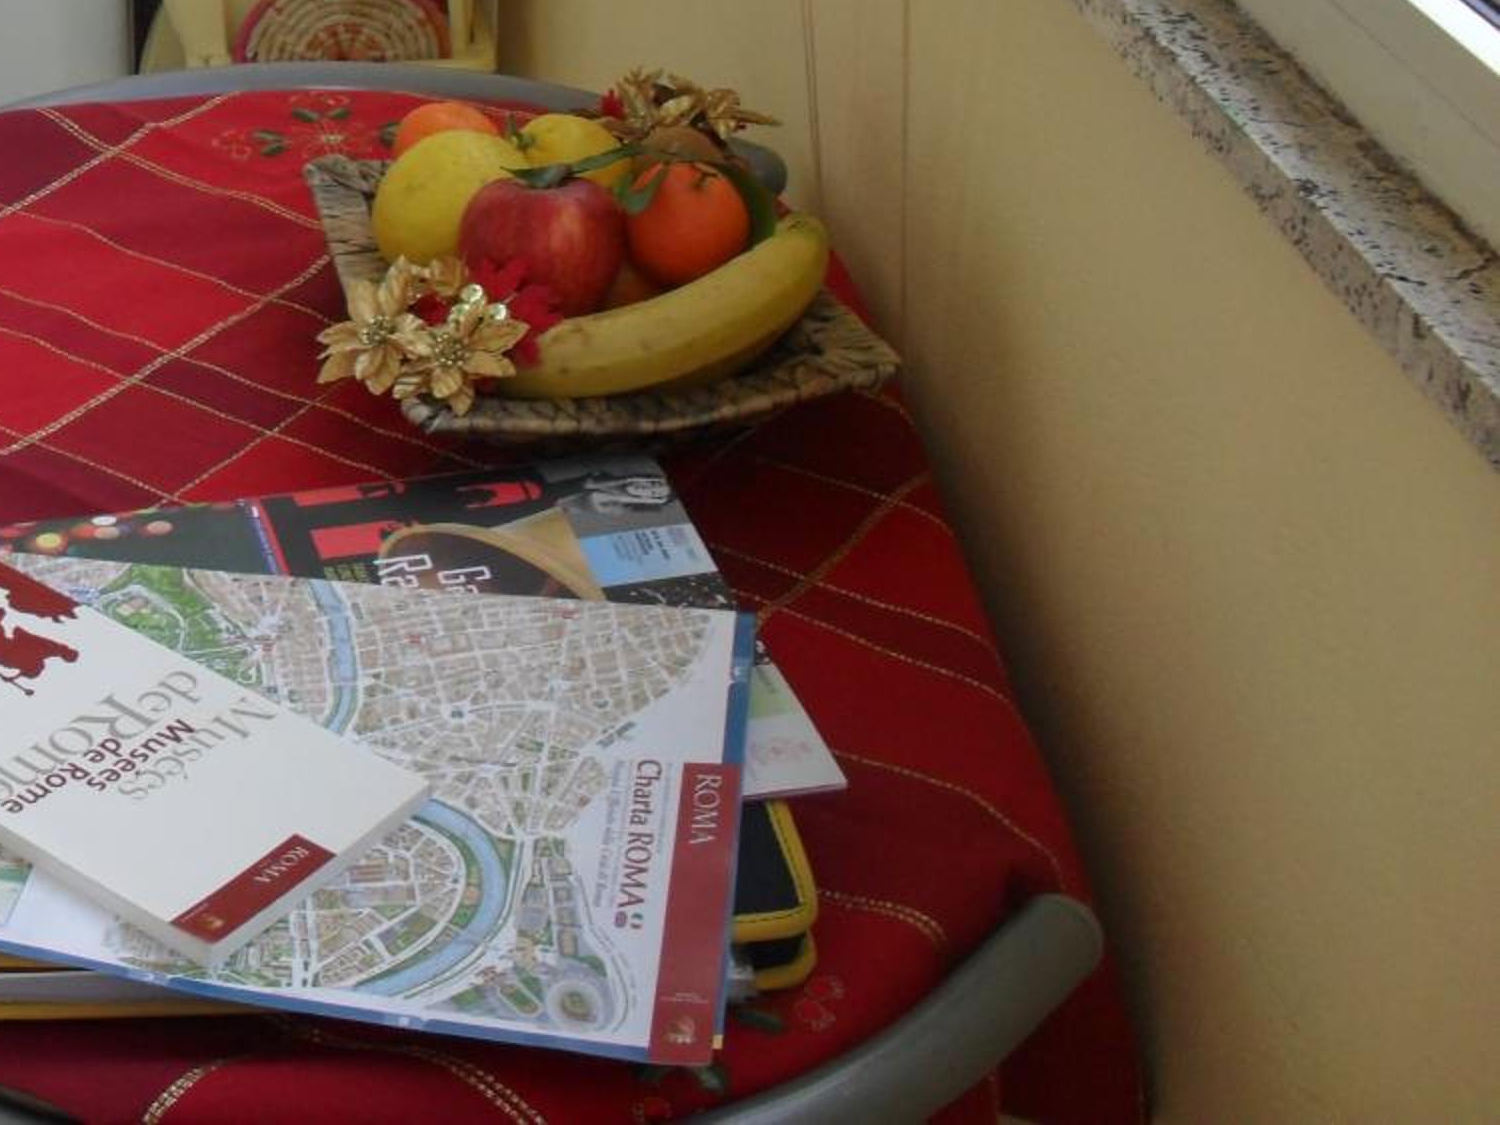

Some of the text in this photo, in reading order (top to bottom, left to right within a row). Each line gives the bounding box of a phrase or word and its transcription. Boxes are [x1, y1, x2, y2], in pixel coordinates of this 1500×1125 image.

[1, 738, 121, 815] de Rome
[689, 774, 723, 845] ROMA
[254, 845, 310, 884] ROMA
[618, 759, 663, 908] Charta ROMA
